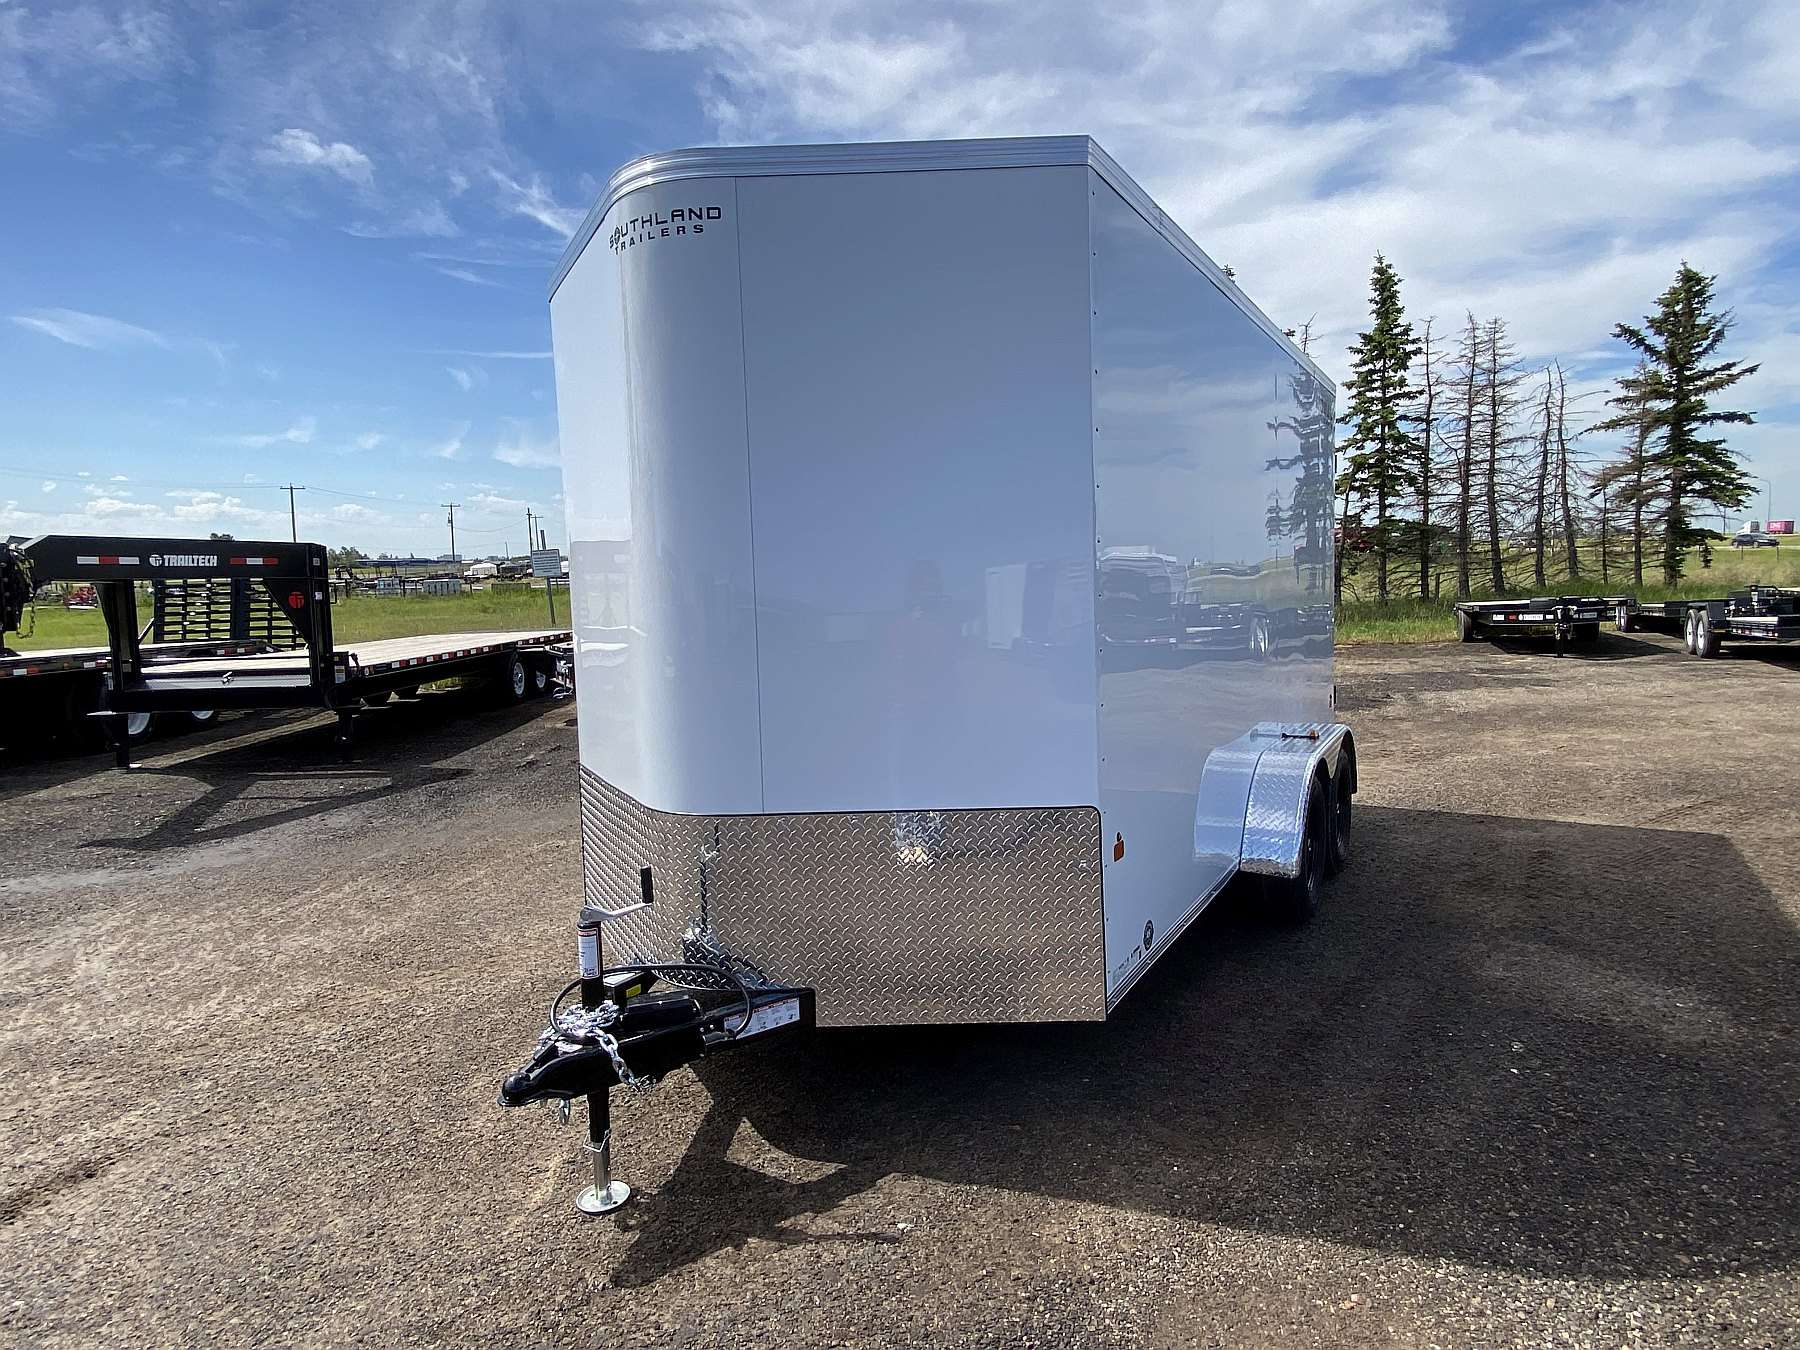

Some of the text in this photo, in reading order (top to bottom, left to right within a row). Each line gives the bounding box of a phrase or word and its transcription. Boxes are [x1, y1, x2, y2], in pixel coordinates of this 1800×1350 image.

[609, 206, 722, 249] SOUTHLAND
[614, 224, 704, 255] TRAILERS
[163, 555, 218, 567] TRAILTECH
